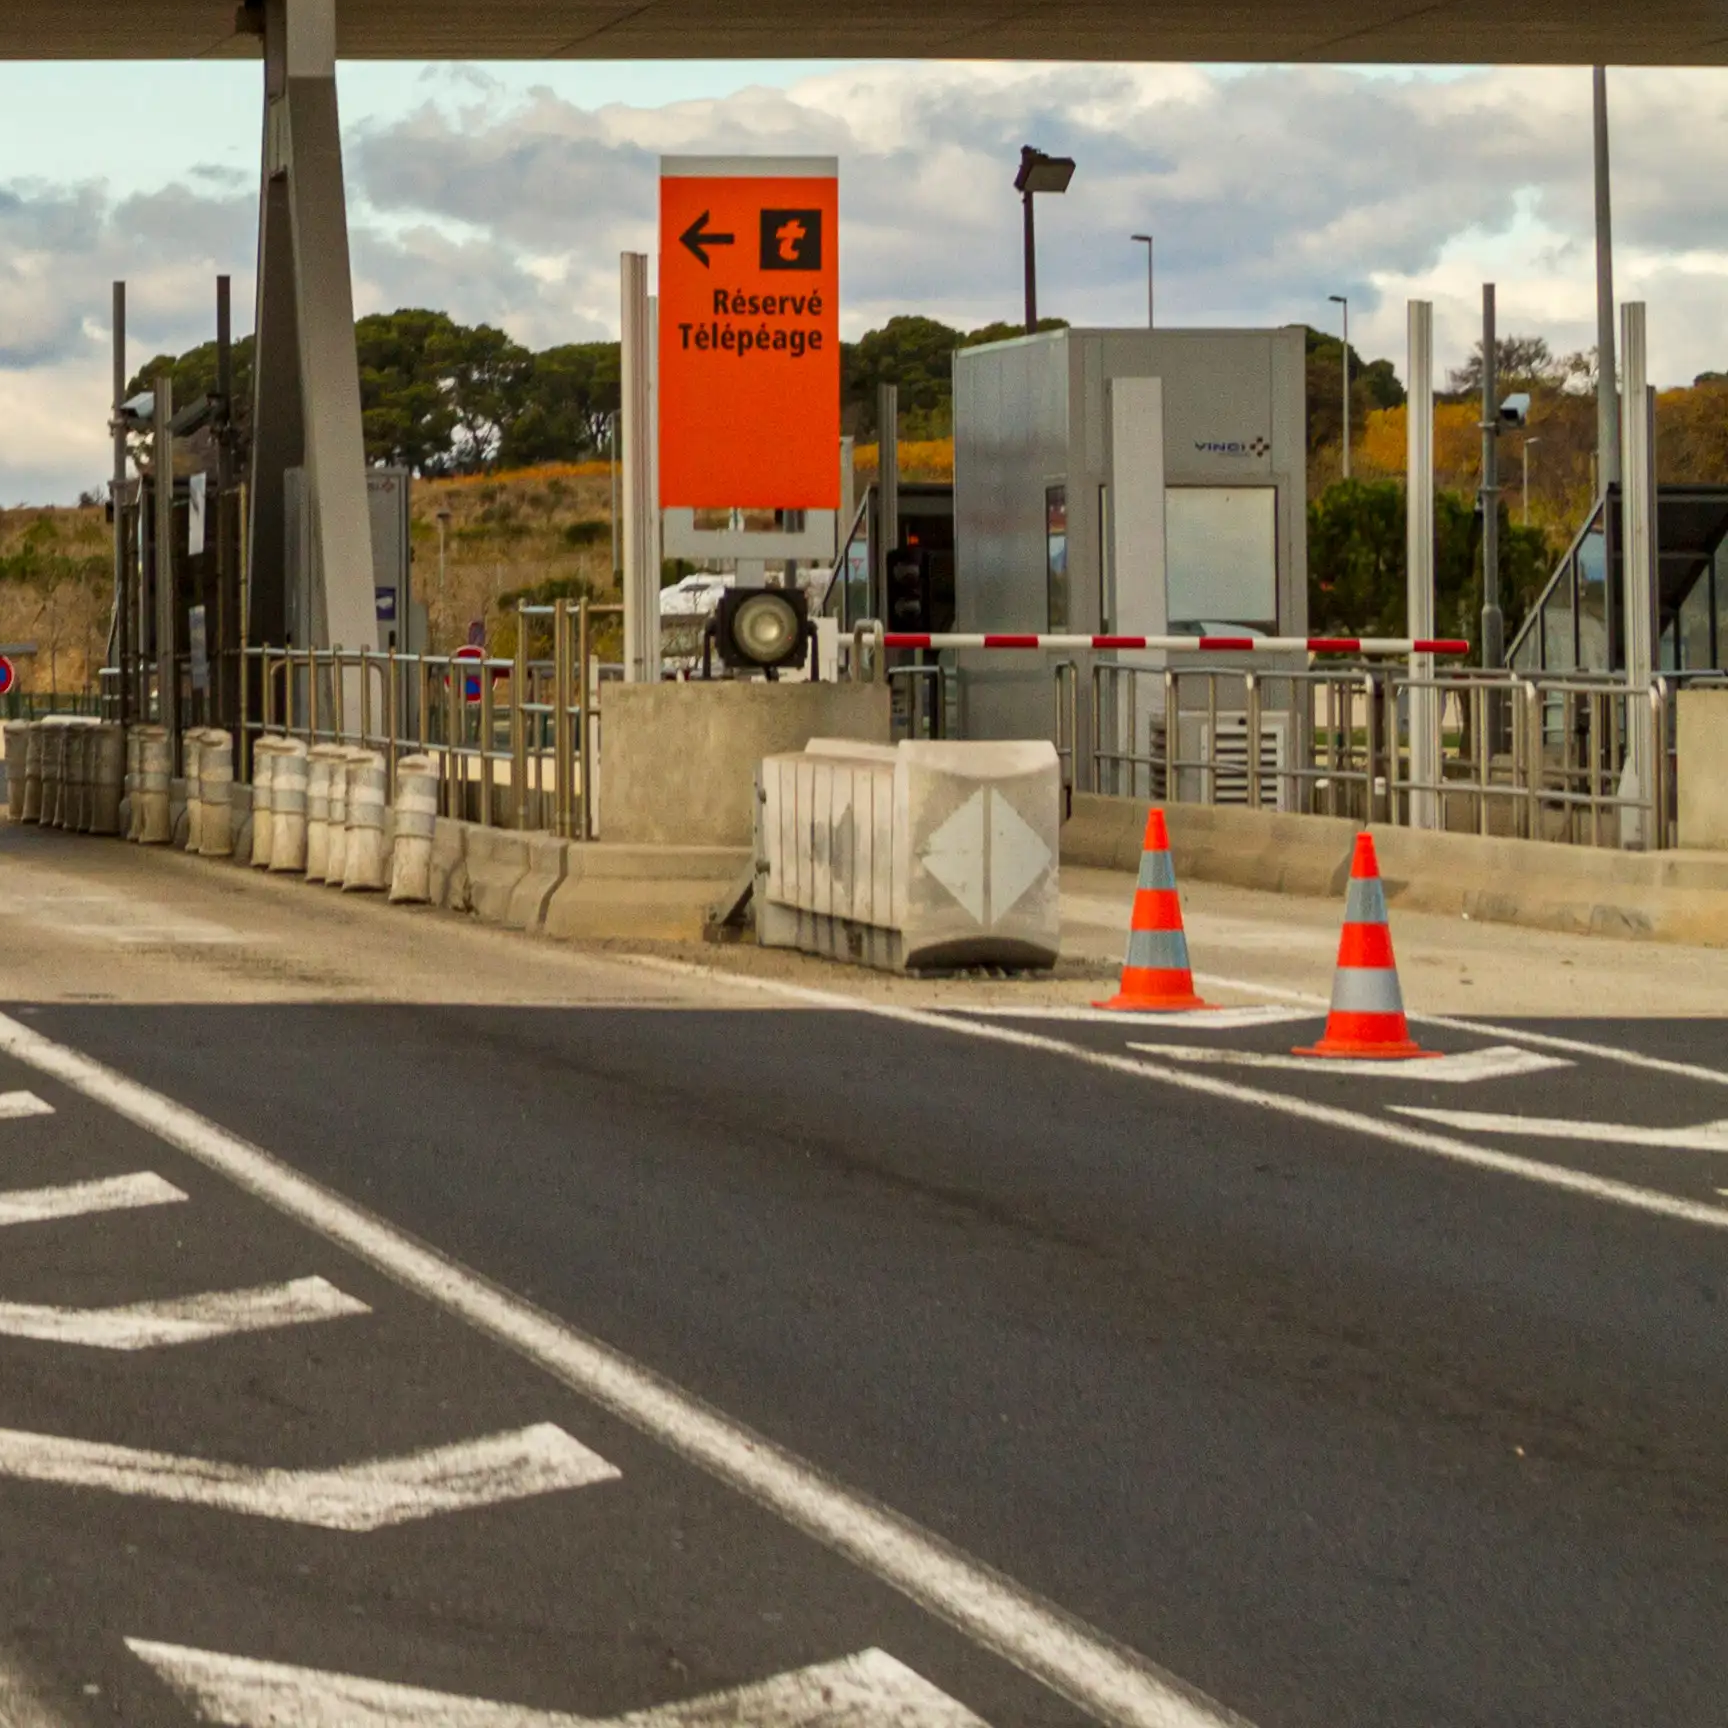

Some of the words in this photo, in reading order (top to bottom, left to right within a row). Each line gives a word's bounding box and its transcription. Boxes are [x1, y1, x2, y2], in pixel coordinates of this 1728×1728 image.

[713, 289, 822, 315] Réservé
[678, 323, 822, 357] Télépéage
[1194, 442, 1246, 451] VINCI
